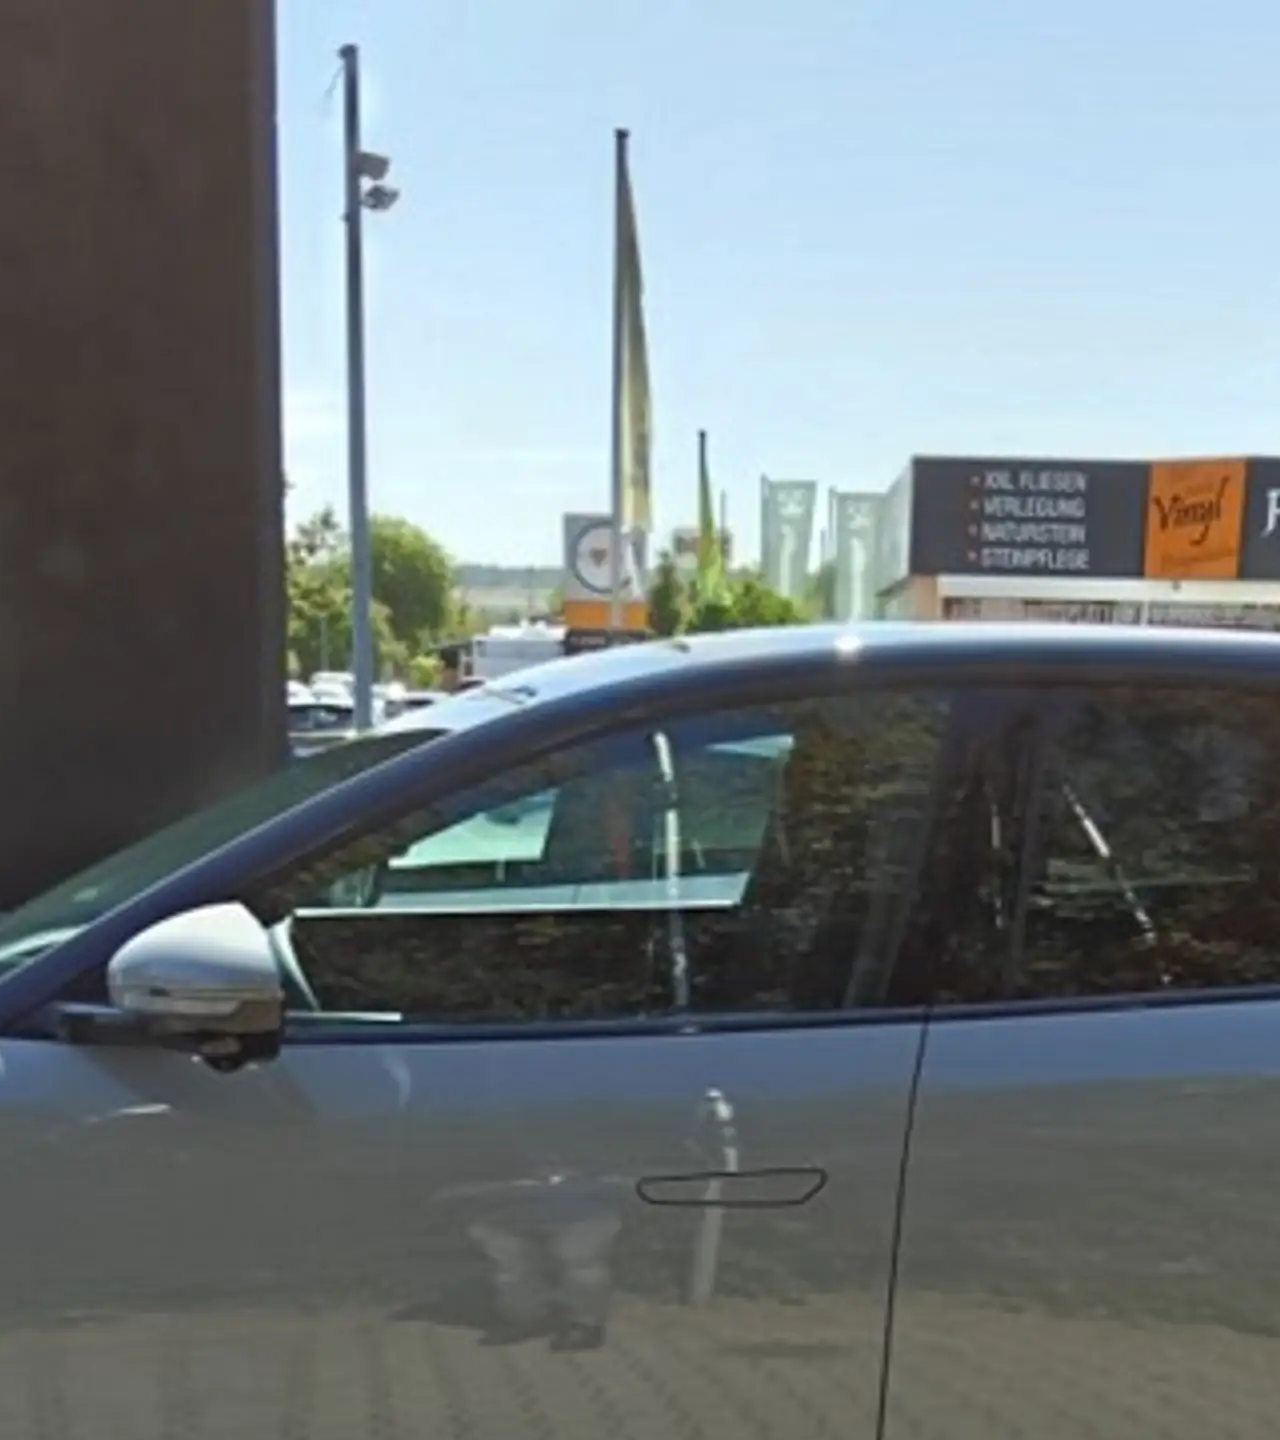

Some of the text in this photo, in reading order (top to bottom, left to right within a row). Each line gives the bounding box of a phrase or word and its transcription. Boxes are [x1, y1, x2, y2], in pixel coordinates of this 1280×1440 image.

[1018, 469, 1088, 492] FLIESEN
[982, 496, 1086, 518] VERLEGUNG
[1153, 475, 1231, 547] Vinyl
[980, 521, 1086, 544] NATURSTEIN
[979, 547, 1089, 570] STEINPFLEGE
